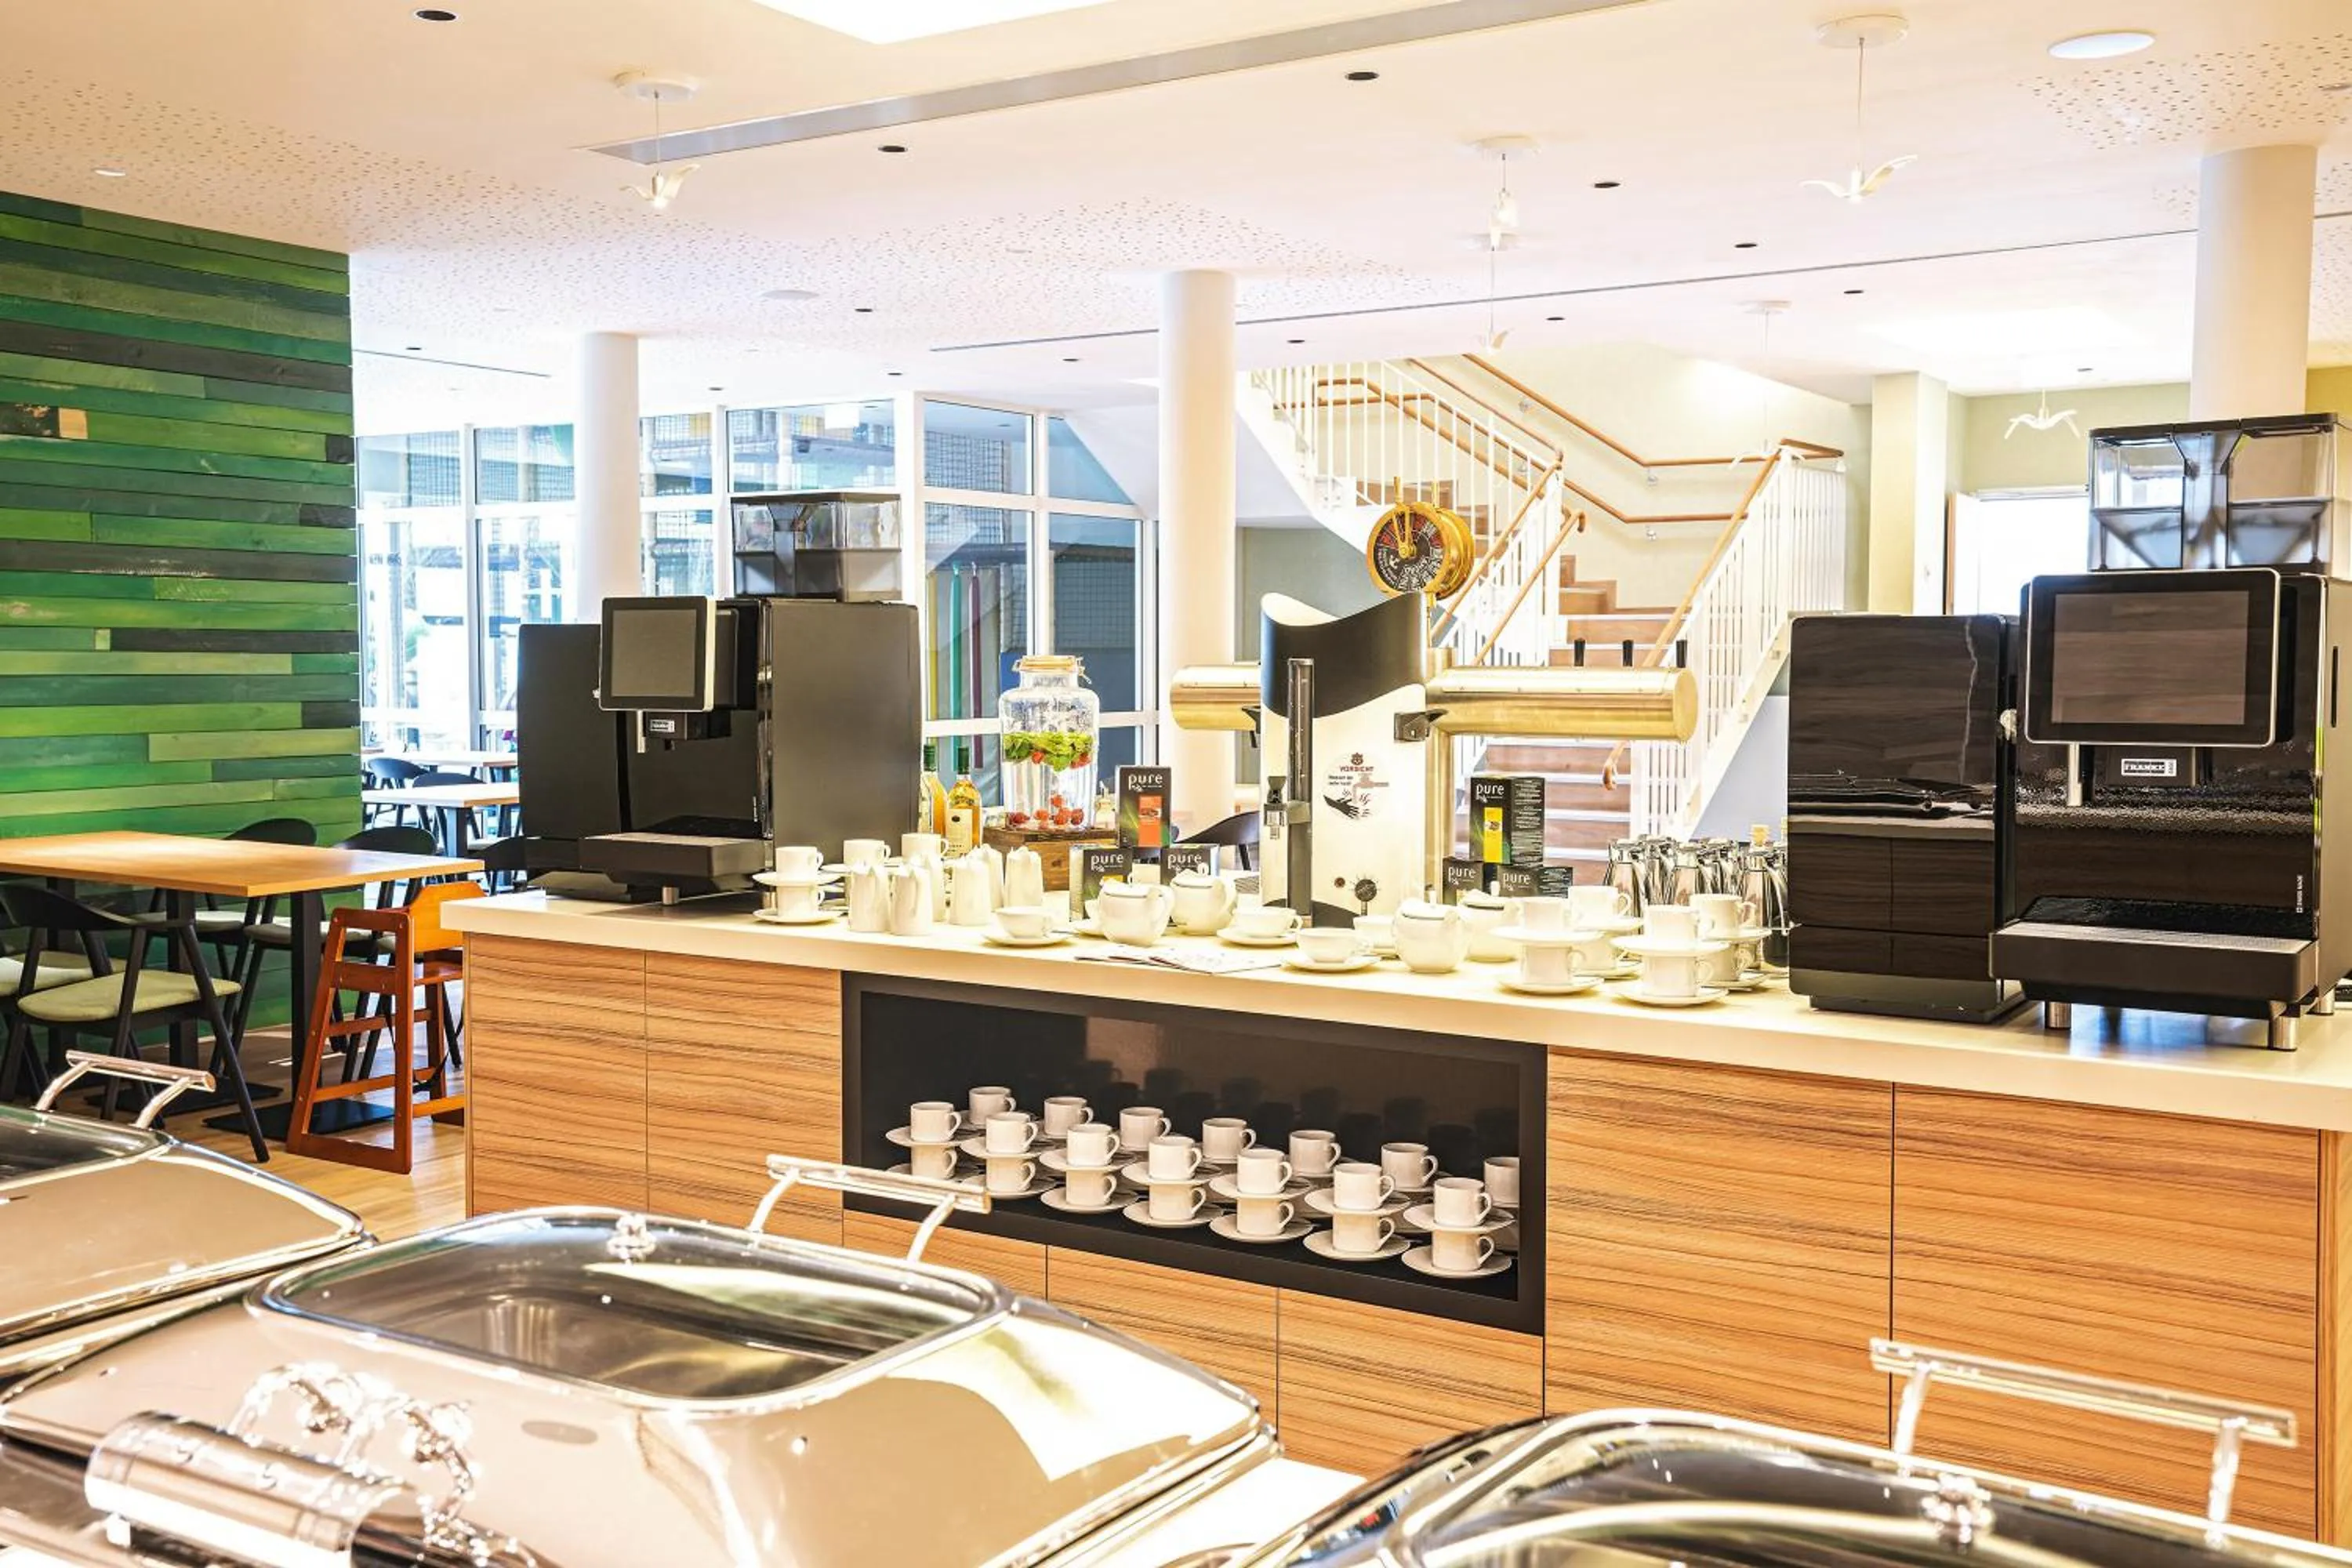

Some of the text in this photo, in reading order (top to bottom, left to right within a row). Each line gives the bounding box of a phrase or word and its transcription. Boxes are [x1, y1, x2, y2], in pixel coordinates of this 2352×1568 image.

[1129, 773, 1163, 790] pure
[1476, 784, 1504, 800] pure
[1091, 853, 1124, 871] pure
[1167, 854, 1202, 869] pure
[1448, 866, 1476, 883] pure
[1502, 872, 1531, 888] pure
